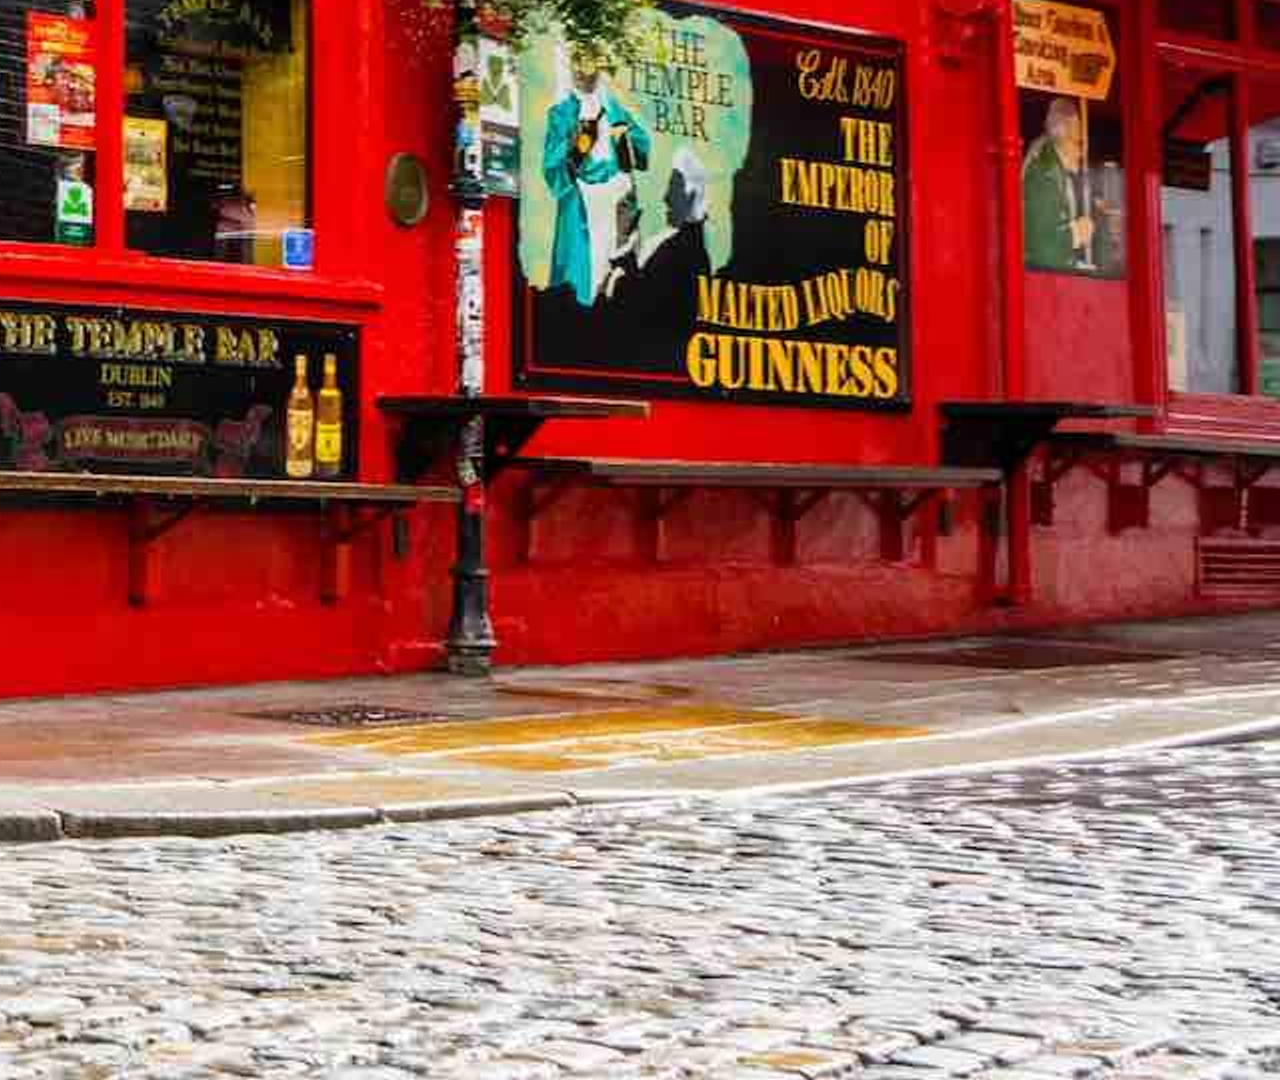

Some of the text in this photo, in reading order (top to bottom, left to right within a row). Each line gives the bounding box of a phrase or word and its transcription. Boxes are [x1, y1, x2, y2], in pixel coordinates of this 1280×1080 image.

[628, 61, 736, 108] TEMPLE
[852, 63, 896, 109] 1840
[654, 98, 710, 143] BAR
[840, 116, 894, 164] THE
[778, 158, 896, 218] EMPEROR
[863, 219, 895, 266] OF
[696, 267, 901, 333] MALTED LIQUORS
[65, 315, 207, 362] TEMPLE
[215, 325, 283, 366] BAR
[100, 363, 173, 387] DUBLIN
[686, 331, 899, 400] GUINNESS
